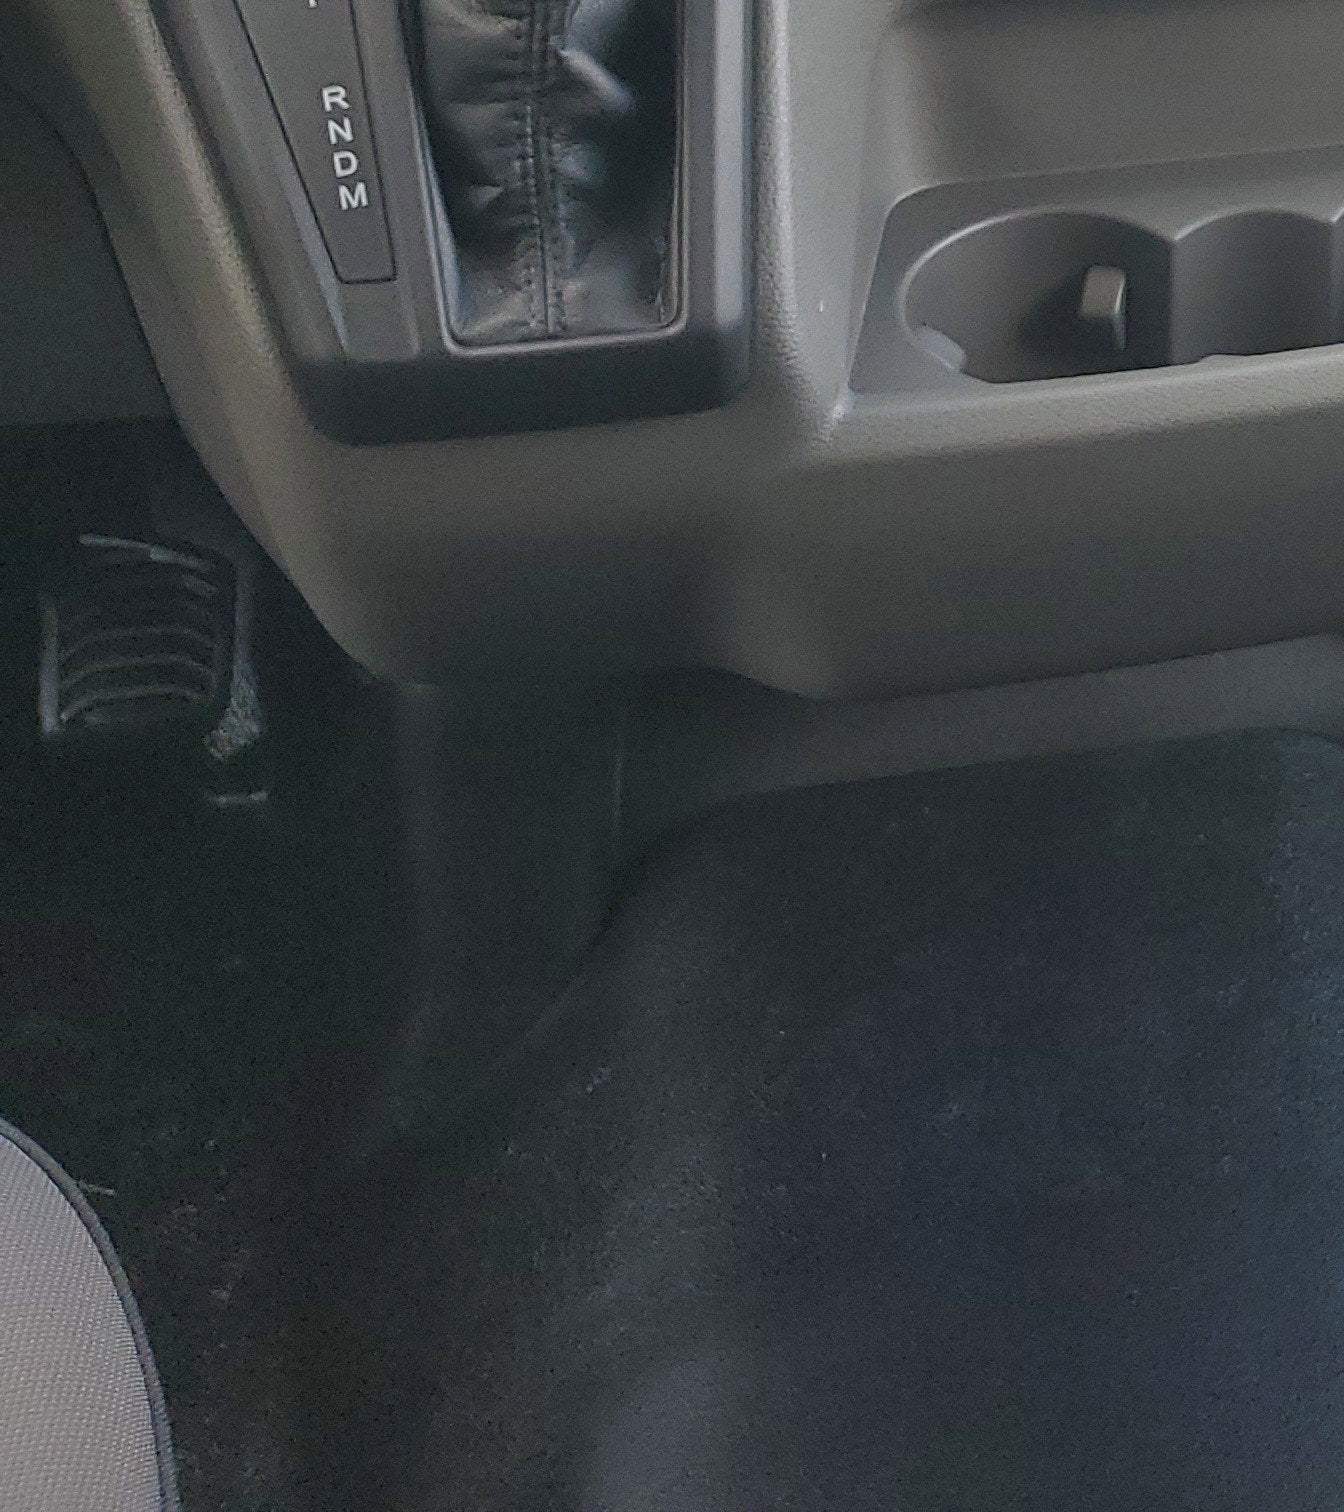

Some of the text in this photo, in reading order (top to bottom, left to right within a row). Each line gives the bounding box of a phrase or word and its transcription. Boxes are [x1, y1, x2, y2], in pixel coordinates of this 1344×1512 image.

[322, 86, 350, 113] R
[329, 118, 354, 145] N
[334, 151, 360, 179] D
[338, 181, 370, 211] M
